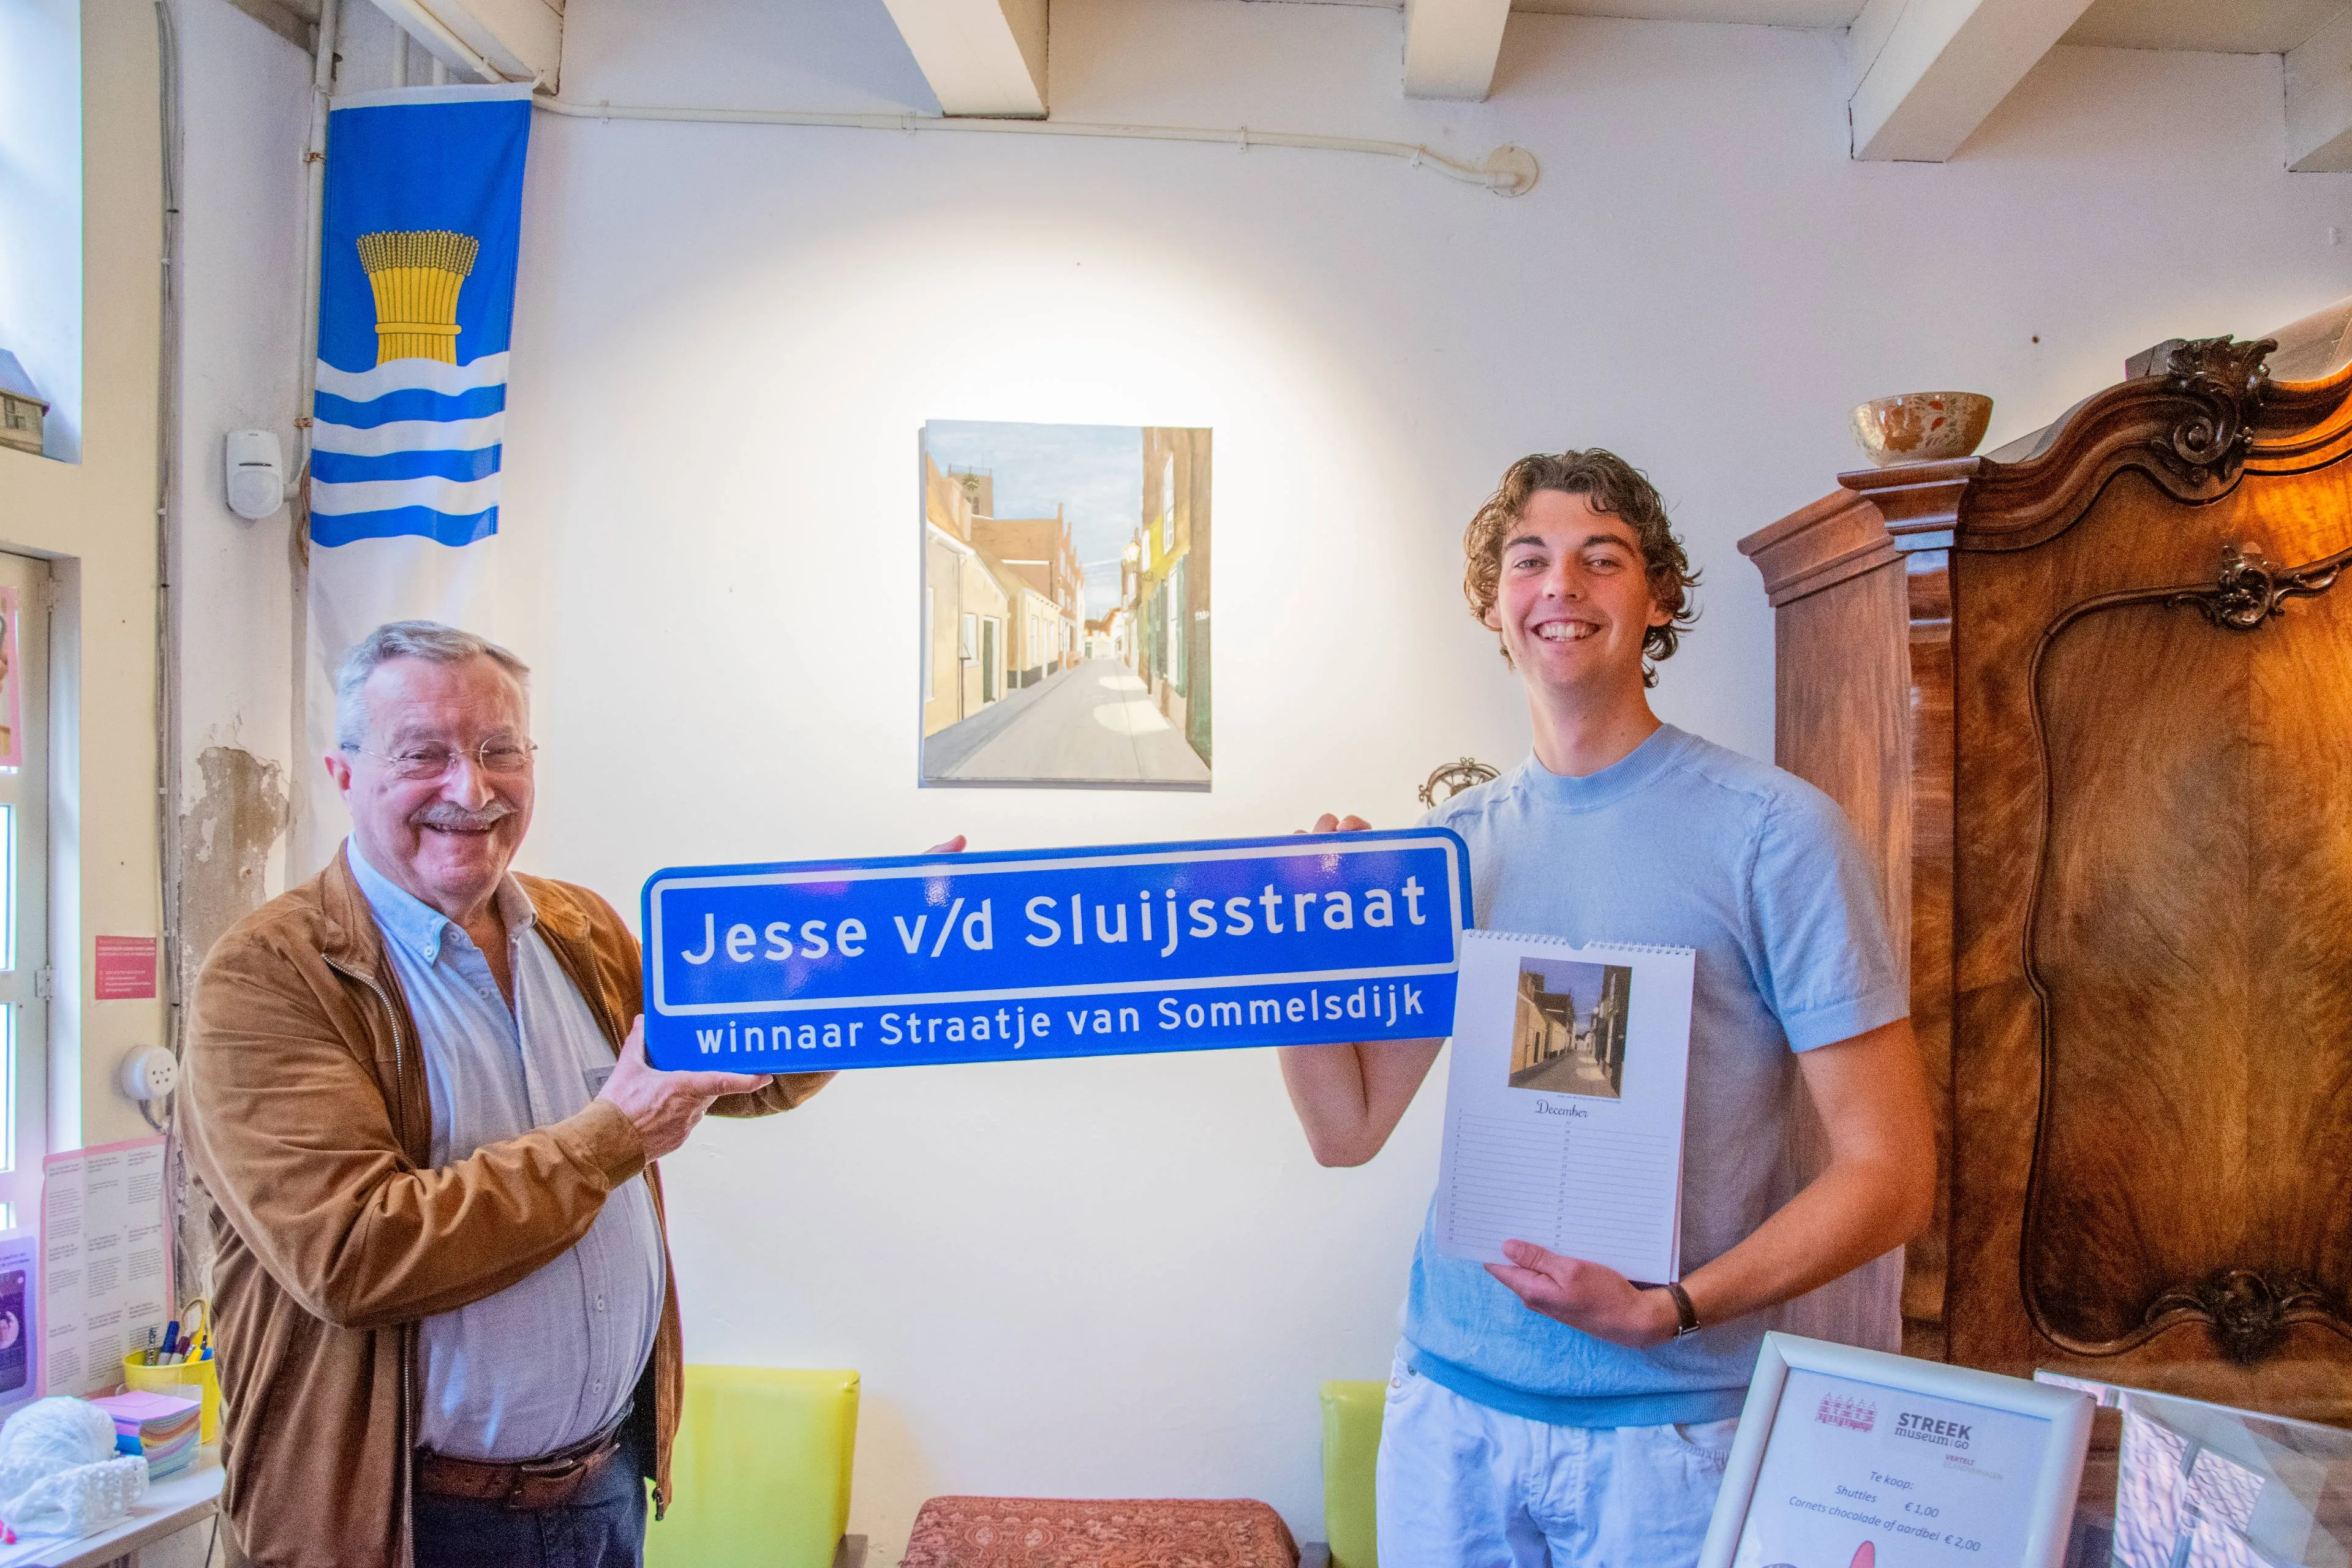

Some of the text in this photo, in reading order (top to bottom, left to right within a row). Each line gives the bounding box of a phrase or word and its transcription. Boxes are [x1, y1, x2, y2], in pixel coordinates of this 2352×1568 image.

[680, 875, 1427, 965] Jesse v/d Sluijsstraat
[696, 982, 1425, 1054] winnaar Straatje van Sommelsdijk
[1534, 1099, 1588, 1118] December
[1894, 1427, 1969, 1450] museum GO
[1898, 1412, 1972, 1441] STREEK
[1945, 1454, 1975, 1466] VERTELT
[1870, 1471, 1915, 1490] Te koop:
[1834, 1485, 1877, 1503] Shuttles
[1914, 1504, 1939, 1518] 1,00
[1789, 1496, 1827, 1513] Cornets
[1828, 1506, 1882, 1526] chocolade
[1883, 1520, 1897, 1531] of
[1896, 1524, 1940, 1541] aardbei
[1953, 1537, 1981, 1551] 2,00
